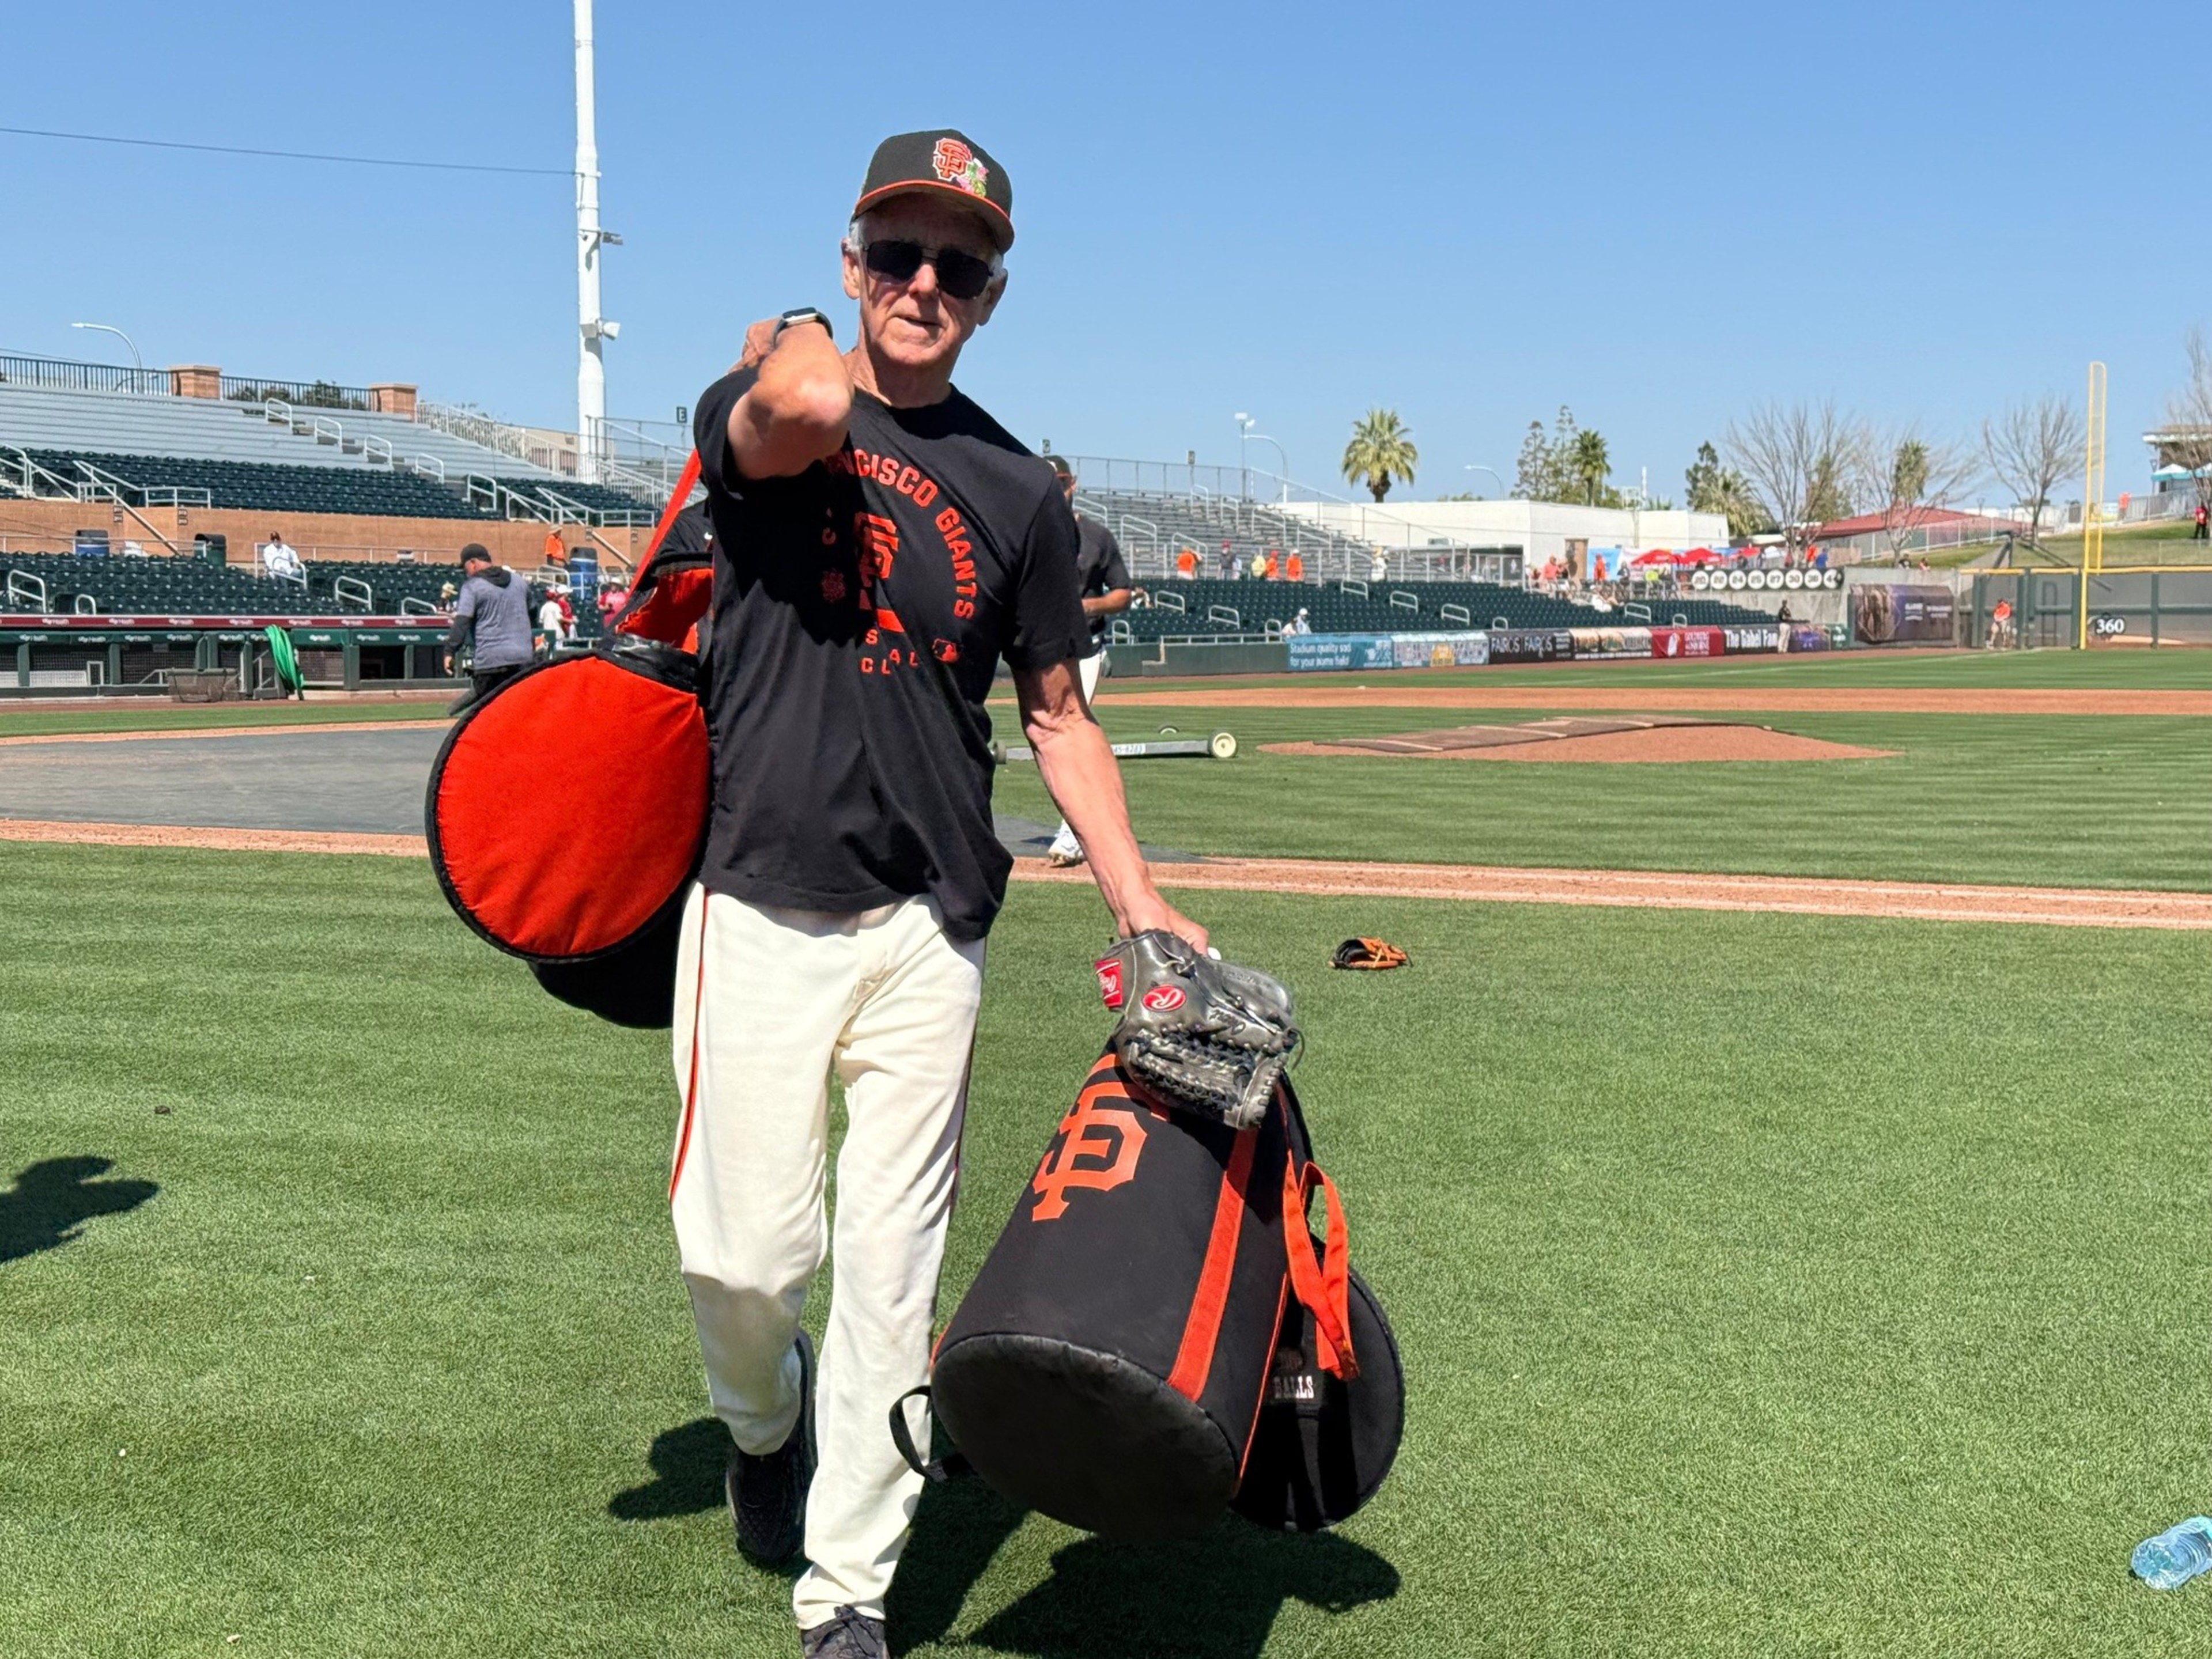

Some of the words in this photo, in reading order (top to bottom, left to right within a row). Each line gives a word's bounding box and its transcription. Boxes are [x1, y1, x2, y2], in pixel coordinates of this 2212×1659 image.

[933, 138, 973, 181] SF
[935, 506, 978, 620] GIANTS
[2096, 618, 2125, 634] 360
[1290, 642, 1316, 654] Stadium
[1317, 642, 1338, 656] quality
[1290, 656, 1299, 667] for
[1300, 658, 1315, 669] your
[1274, 1375, 1315, 1399] BALLS
